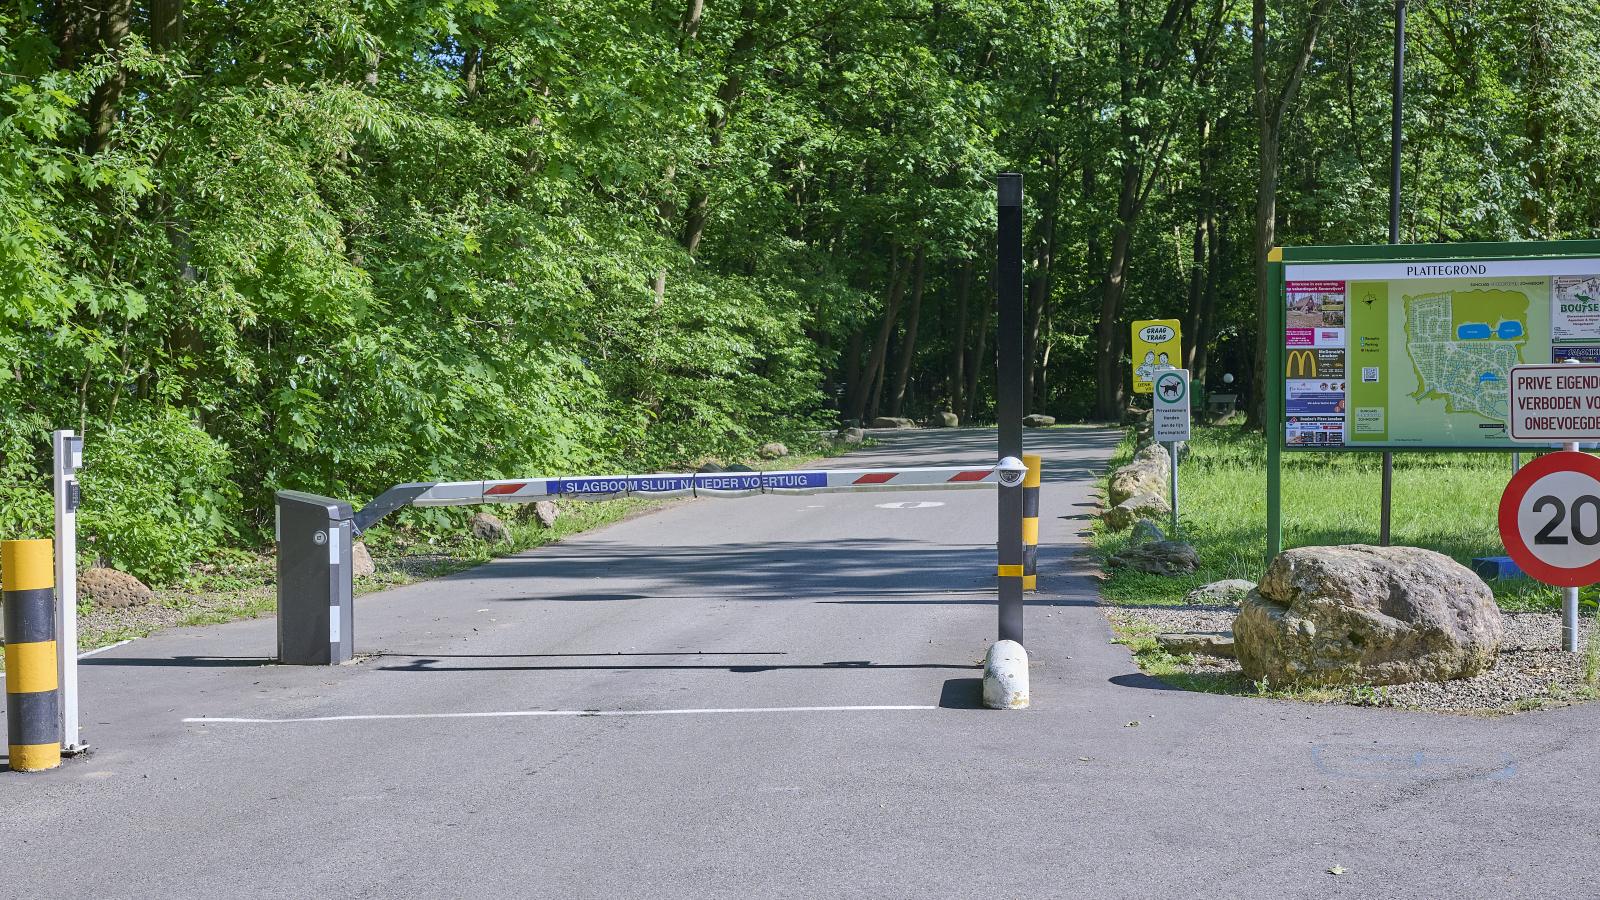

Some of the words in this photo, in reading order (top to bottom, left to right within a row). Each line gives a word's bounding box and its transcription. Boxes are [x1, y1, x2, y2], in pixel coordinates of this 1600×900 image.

[1407, 264, 1487, 276] PLATTEGROND
[1518, 376, 1552, 390] PRIVE
[1556, 375, 1600, 390] EIGEND
[1518, 396, 1581, 410] VERBODEN
[1586, 396, 1600, 409] VO
[1525, 416, 1600, 430] ONBEVOEGDE
[566, 480, 638, 493] SLAGBOOM
[640, 479, 678, 491] SLUIT
[701, 478, 739, 489] IEDER
[742, 475, 808, 488] VOERTUIG
[1532, 494, 1600, 545] 20
